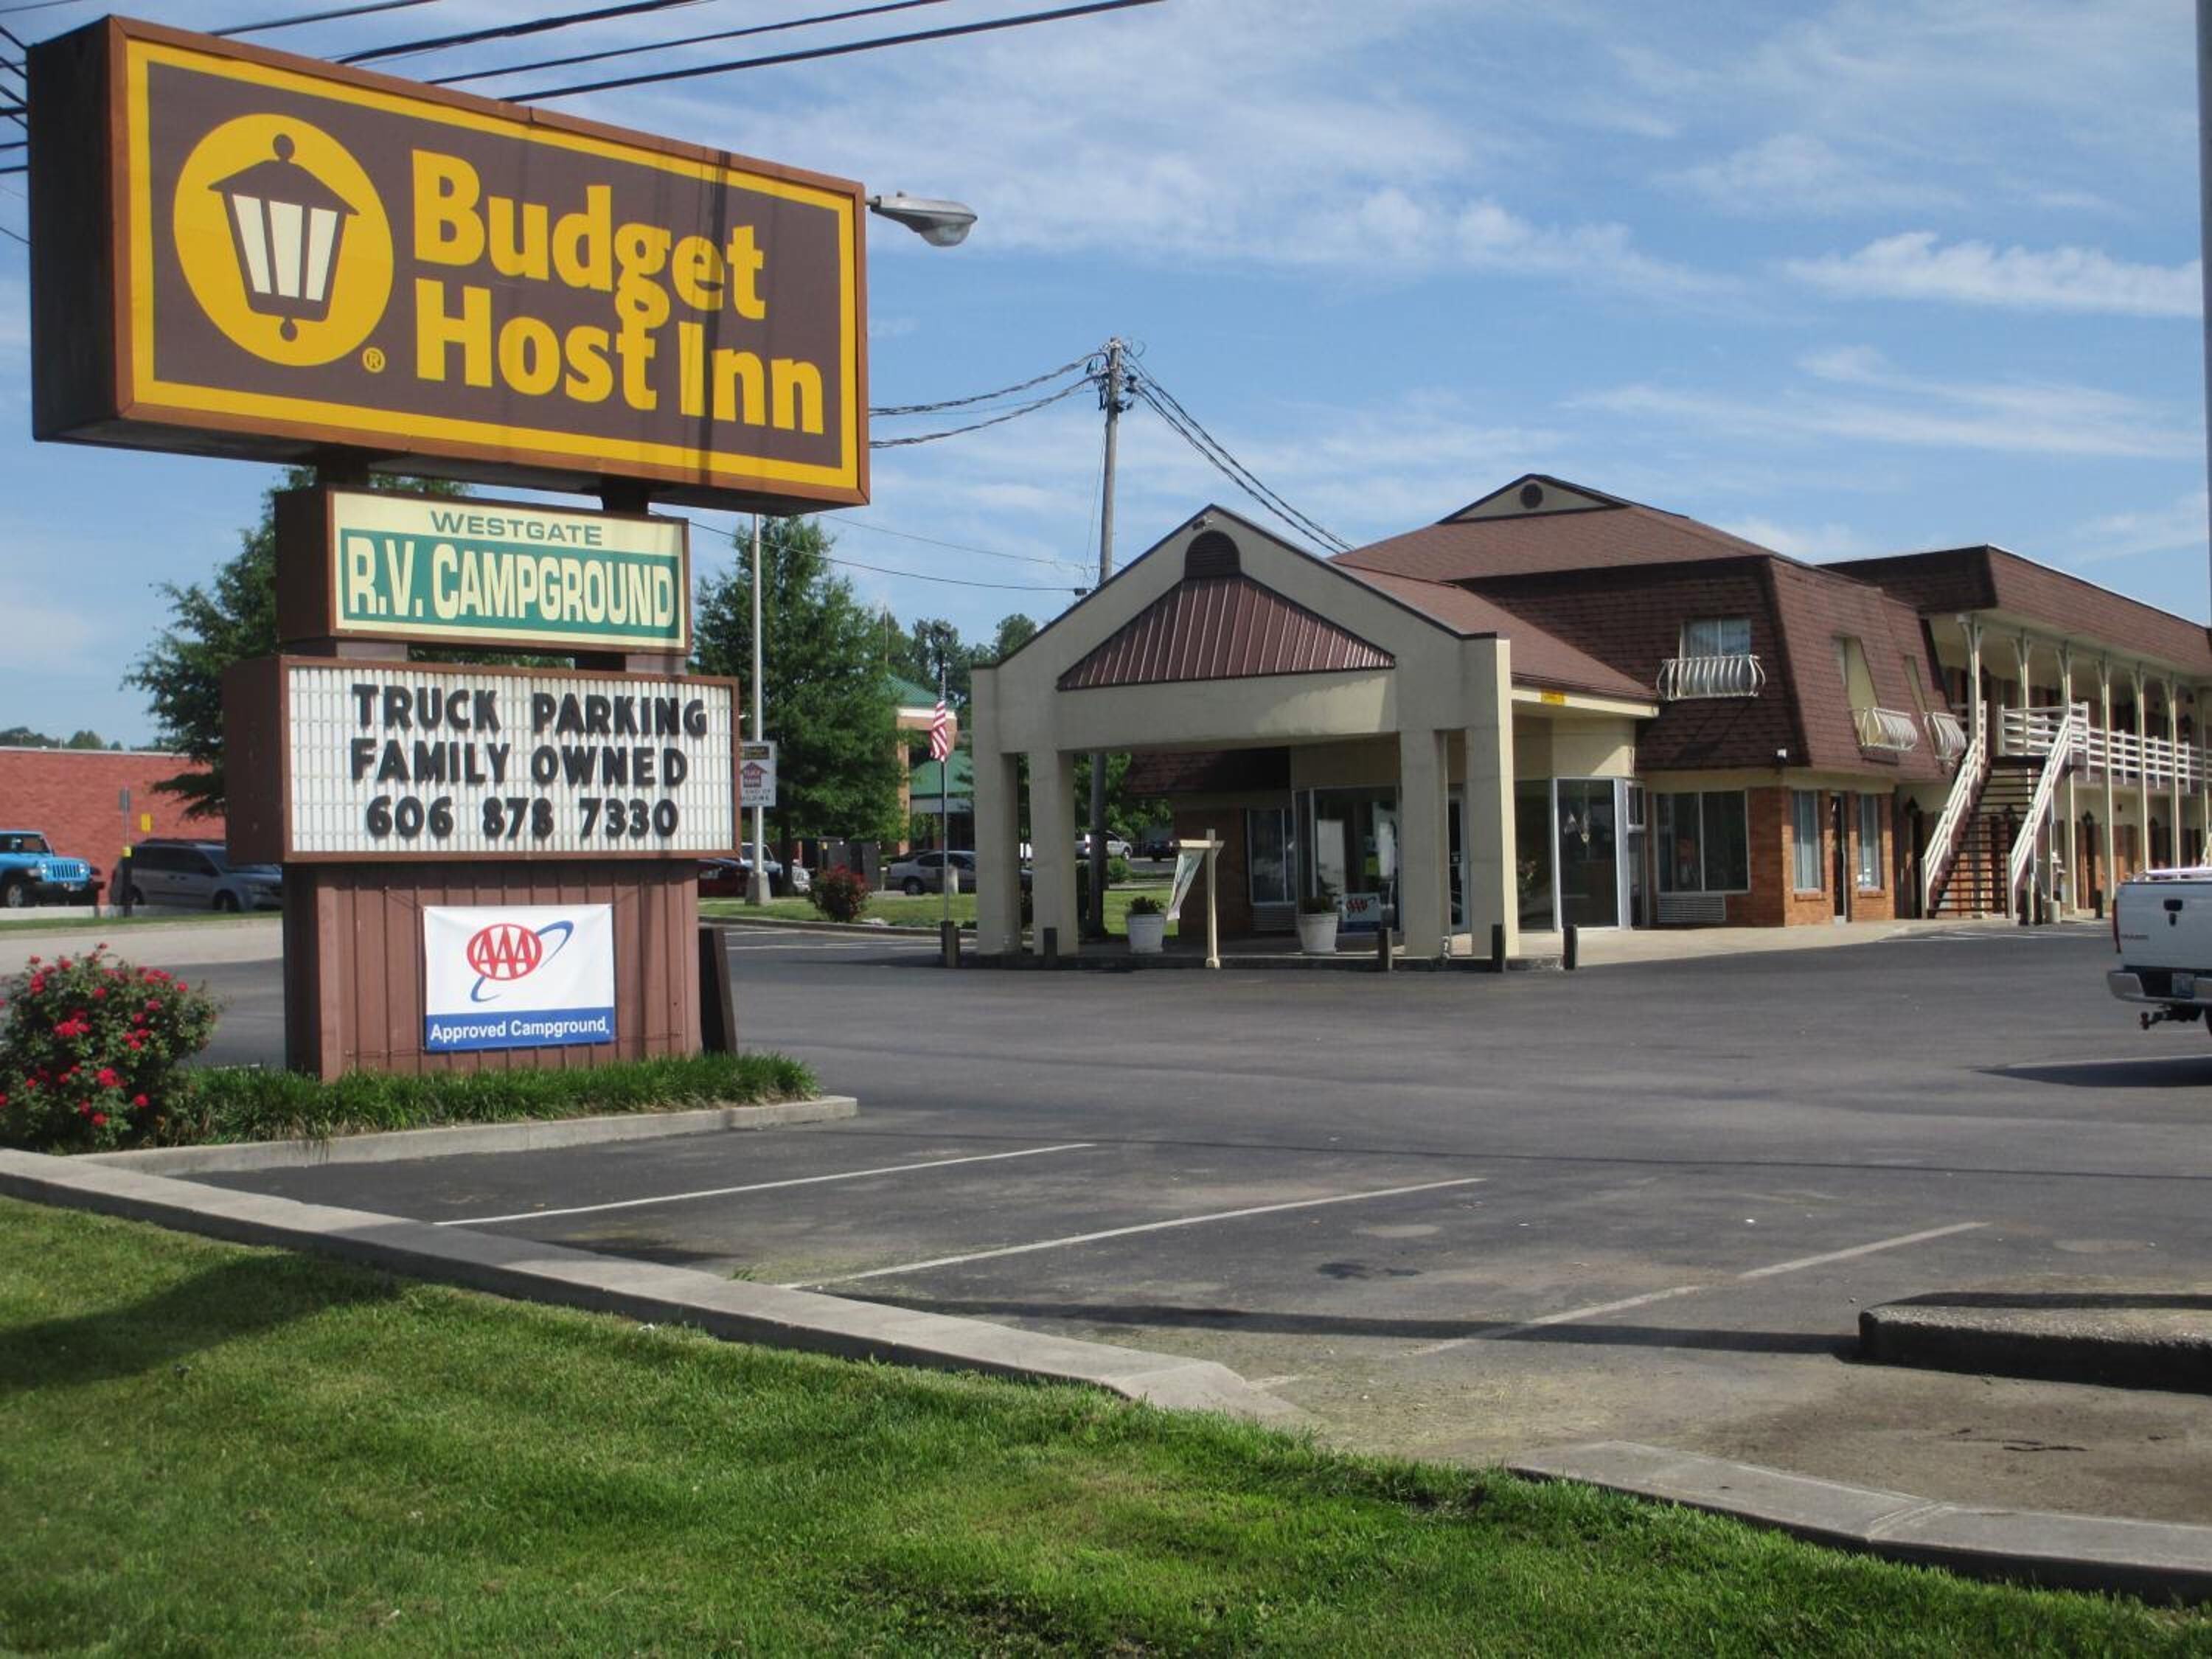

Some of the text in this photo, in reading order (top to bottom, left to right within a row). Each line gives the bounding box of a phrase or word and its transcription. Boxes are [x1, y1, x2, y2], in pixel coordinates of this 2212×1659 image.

[411, 149, 765, 329] Budget
[415, 279, 824, 435] Host Inn
[430, 510, 602, 546] WESTGATE
[347, 536, 674, 628] R.V. CAMPGROUND
[352, 684, 708, 737] TRUCK PARKING
[351, 738, 688, 787] FAMILY OWNED
[367, 795, 679, 840] 606 878 7330
[467, 925, 542, 980] AAA
[430, 1022, 507, 1043] Approved
